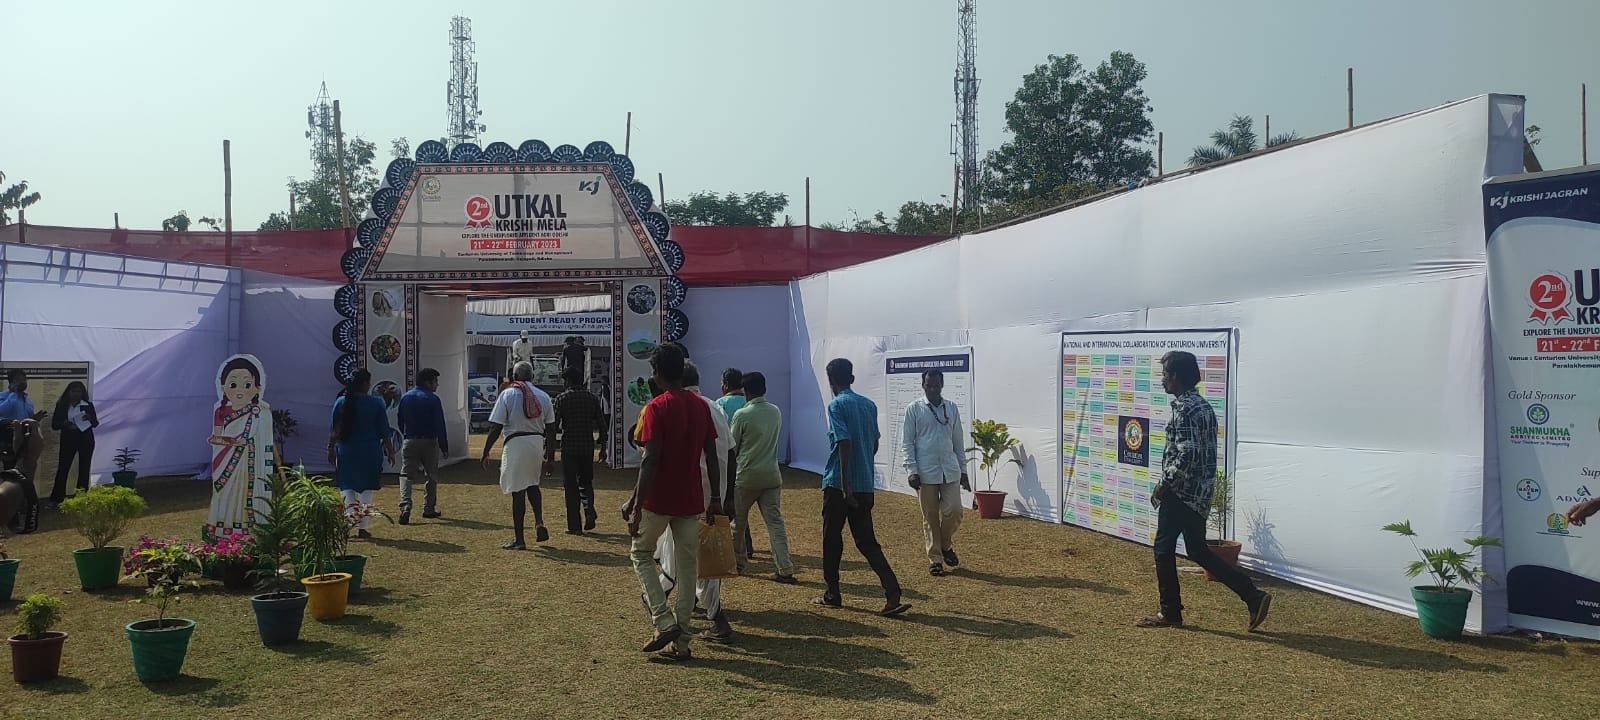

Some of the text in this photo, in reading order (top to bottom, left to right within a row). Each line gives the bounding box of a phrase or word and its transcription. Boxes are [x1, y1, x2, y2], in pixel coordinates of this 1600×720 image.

[1510, 193, 1543, 204] KRISHI
[1544, 187, 1588, 200] JAGRAN
[494, 194, 567, 219] UTKAL
[495, 218, 567, 231] KRISHI MELA
[505, 240, 539, 249] FEBRUARY
[541, 240, 558, 249] 2023
[1537, 280, 1563, 303] 2nd
[1523, 328, 1552, 336] EXPLORE
[1553, 327, 1566, 335] THE
[1123, 340, 1160, 348] COLLABORATION
[1167, 340, 1196, 348] CENTURION
[1196, 340, 1227, 348] UNIVERSITY
[1508, 390, 1576, 402] Gold Sponsor
[1510, 426, 1570, 436] SHANMUKHA
